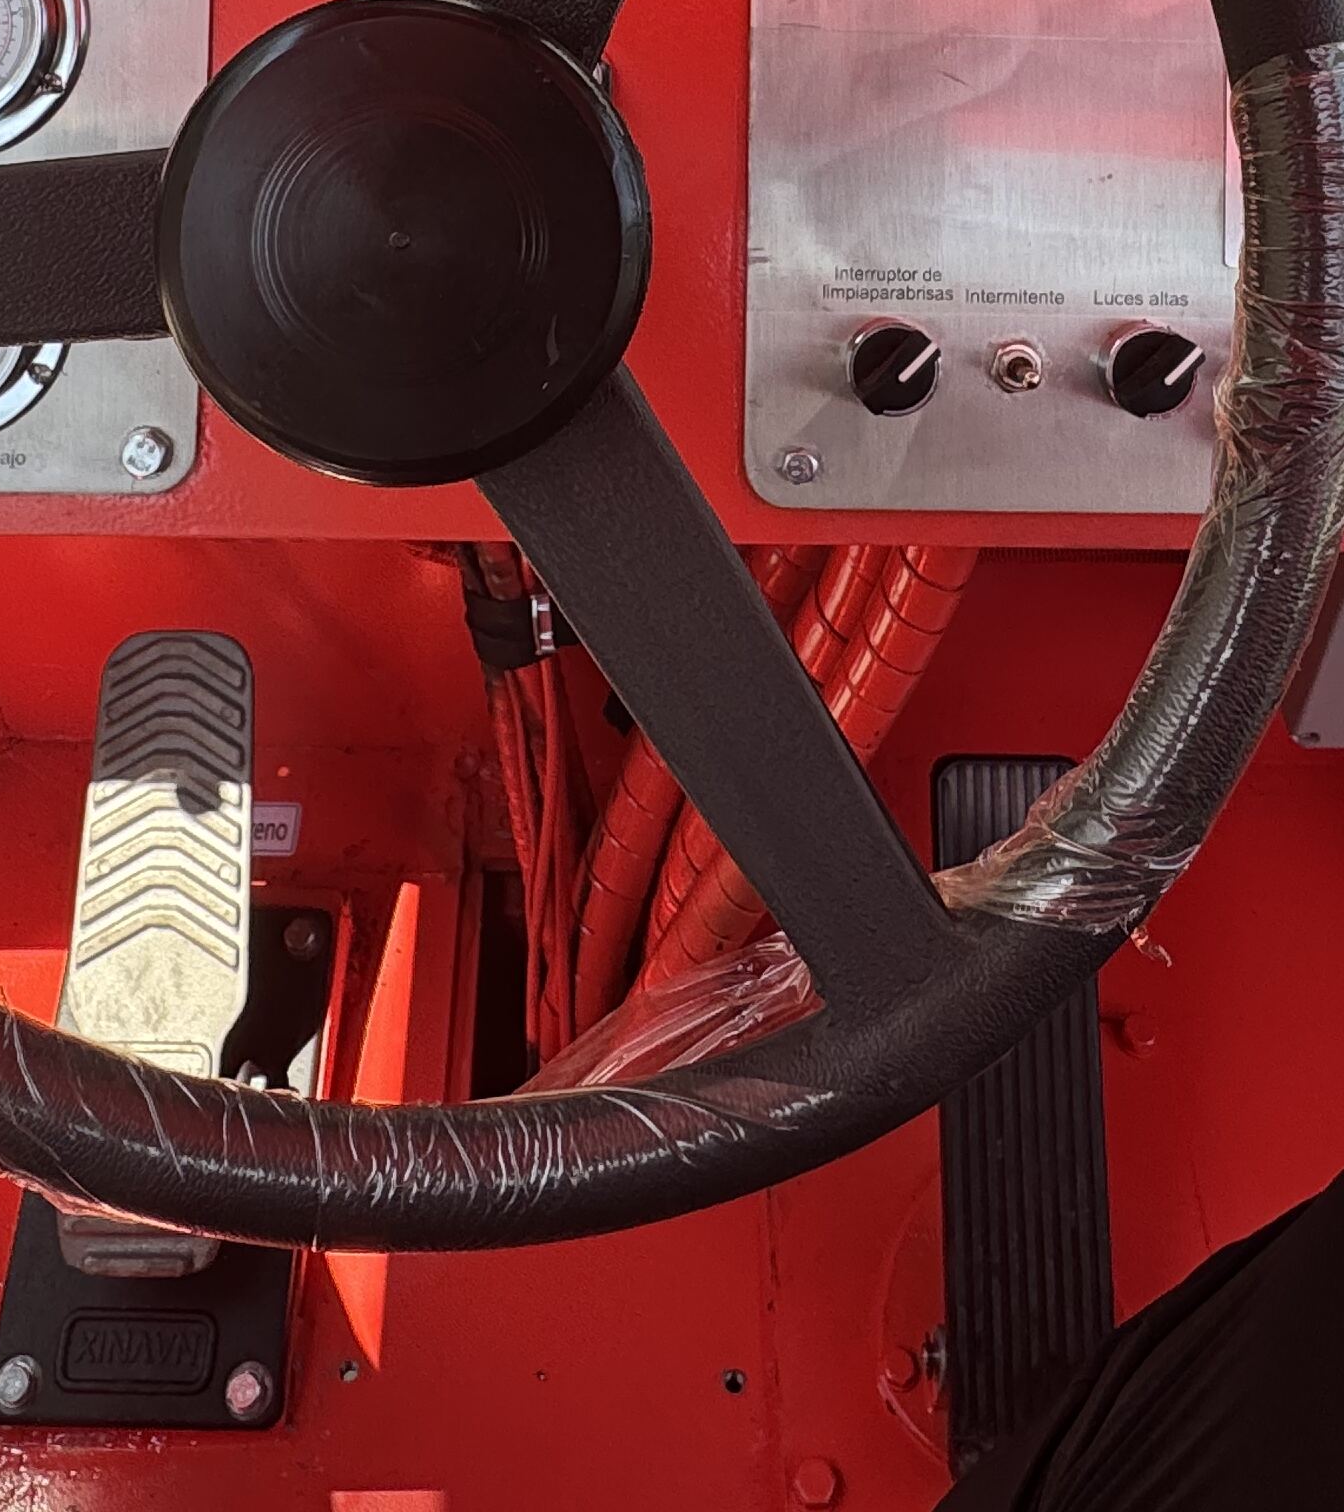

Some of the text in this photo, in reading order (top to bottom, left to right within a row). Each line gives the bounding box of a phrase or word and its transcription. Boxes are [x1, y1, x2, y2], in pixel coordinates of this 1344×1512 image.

[834, 266, 943, 284] Interruptor de
[822, 284, 954, 302] limpiaparabrisas
[965, 288, 1065, 305] Intermitente
[1093, 289, 1189, 306] Luces altas
[252, 822, 288, 841] reno
